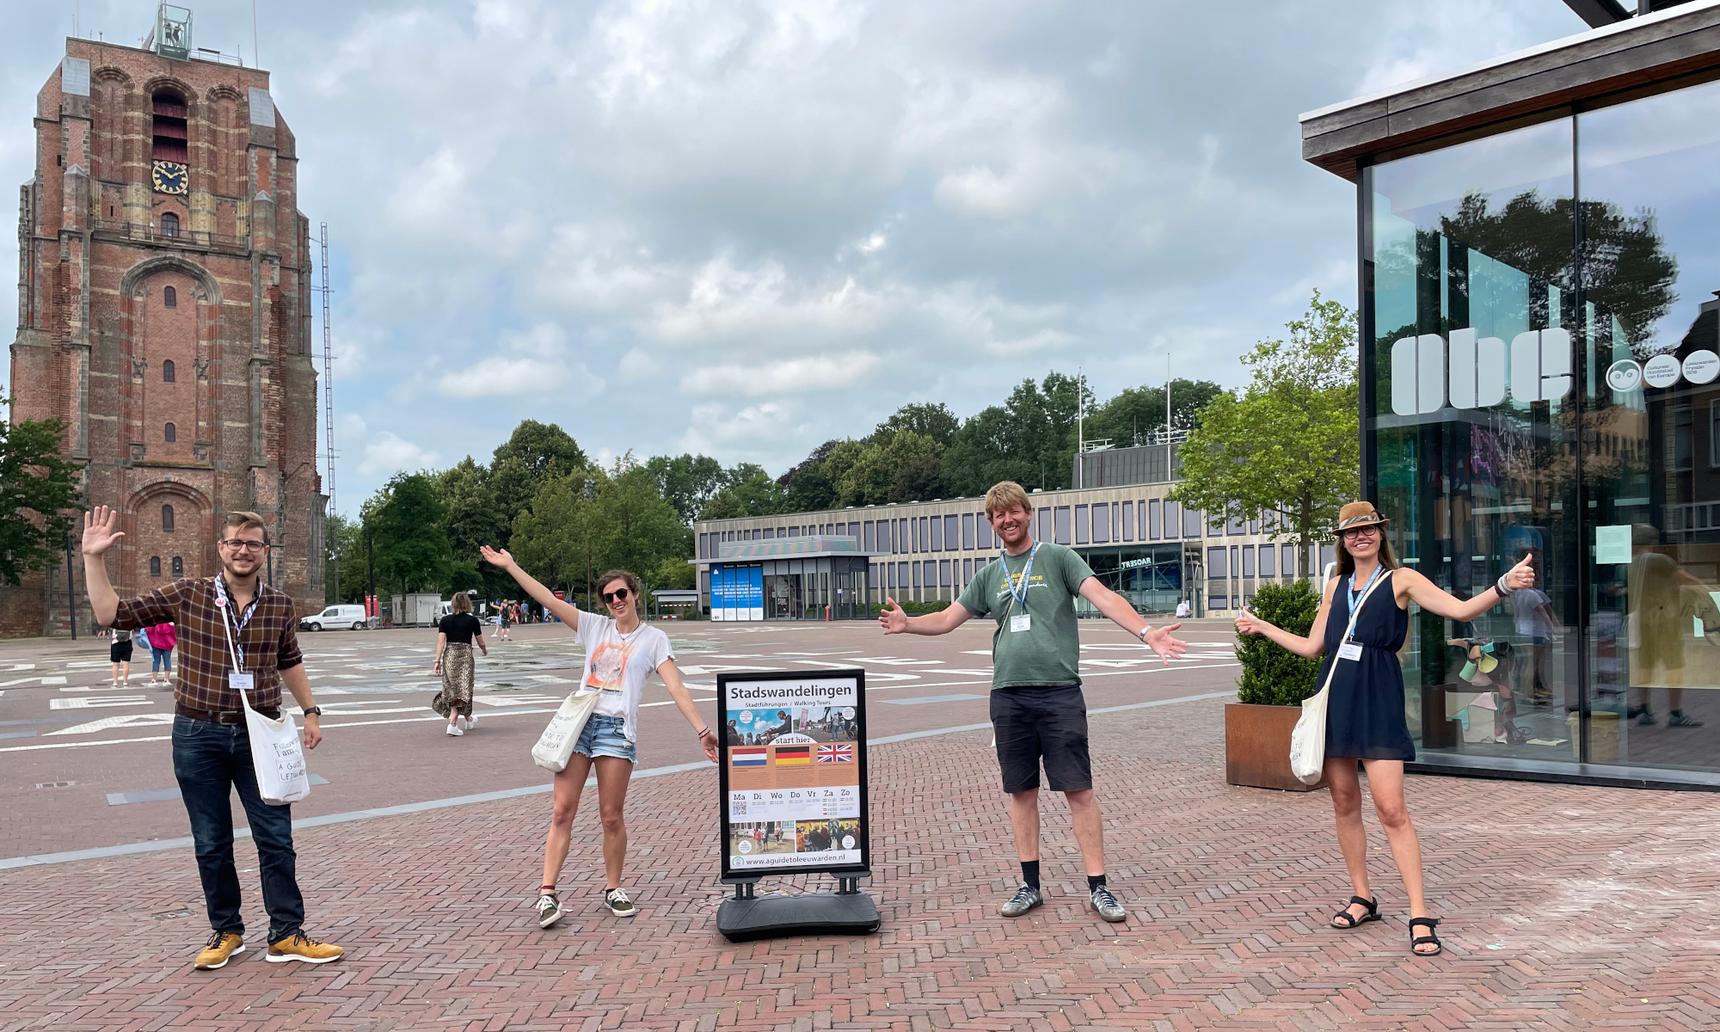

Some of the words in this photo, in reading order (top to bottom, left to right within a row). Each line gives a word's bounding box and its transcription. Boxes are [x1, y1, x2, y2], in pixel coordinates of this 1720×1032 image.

[731, 685, 851, 699] Stadswandelingen
[733, 793, 746, 801] Ma
[746, 854, 846, 865] www.aguidetoleeuwarden.nl
